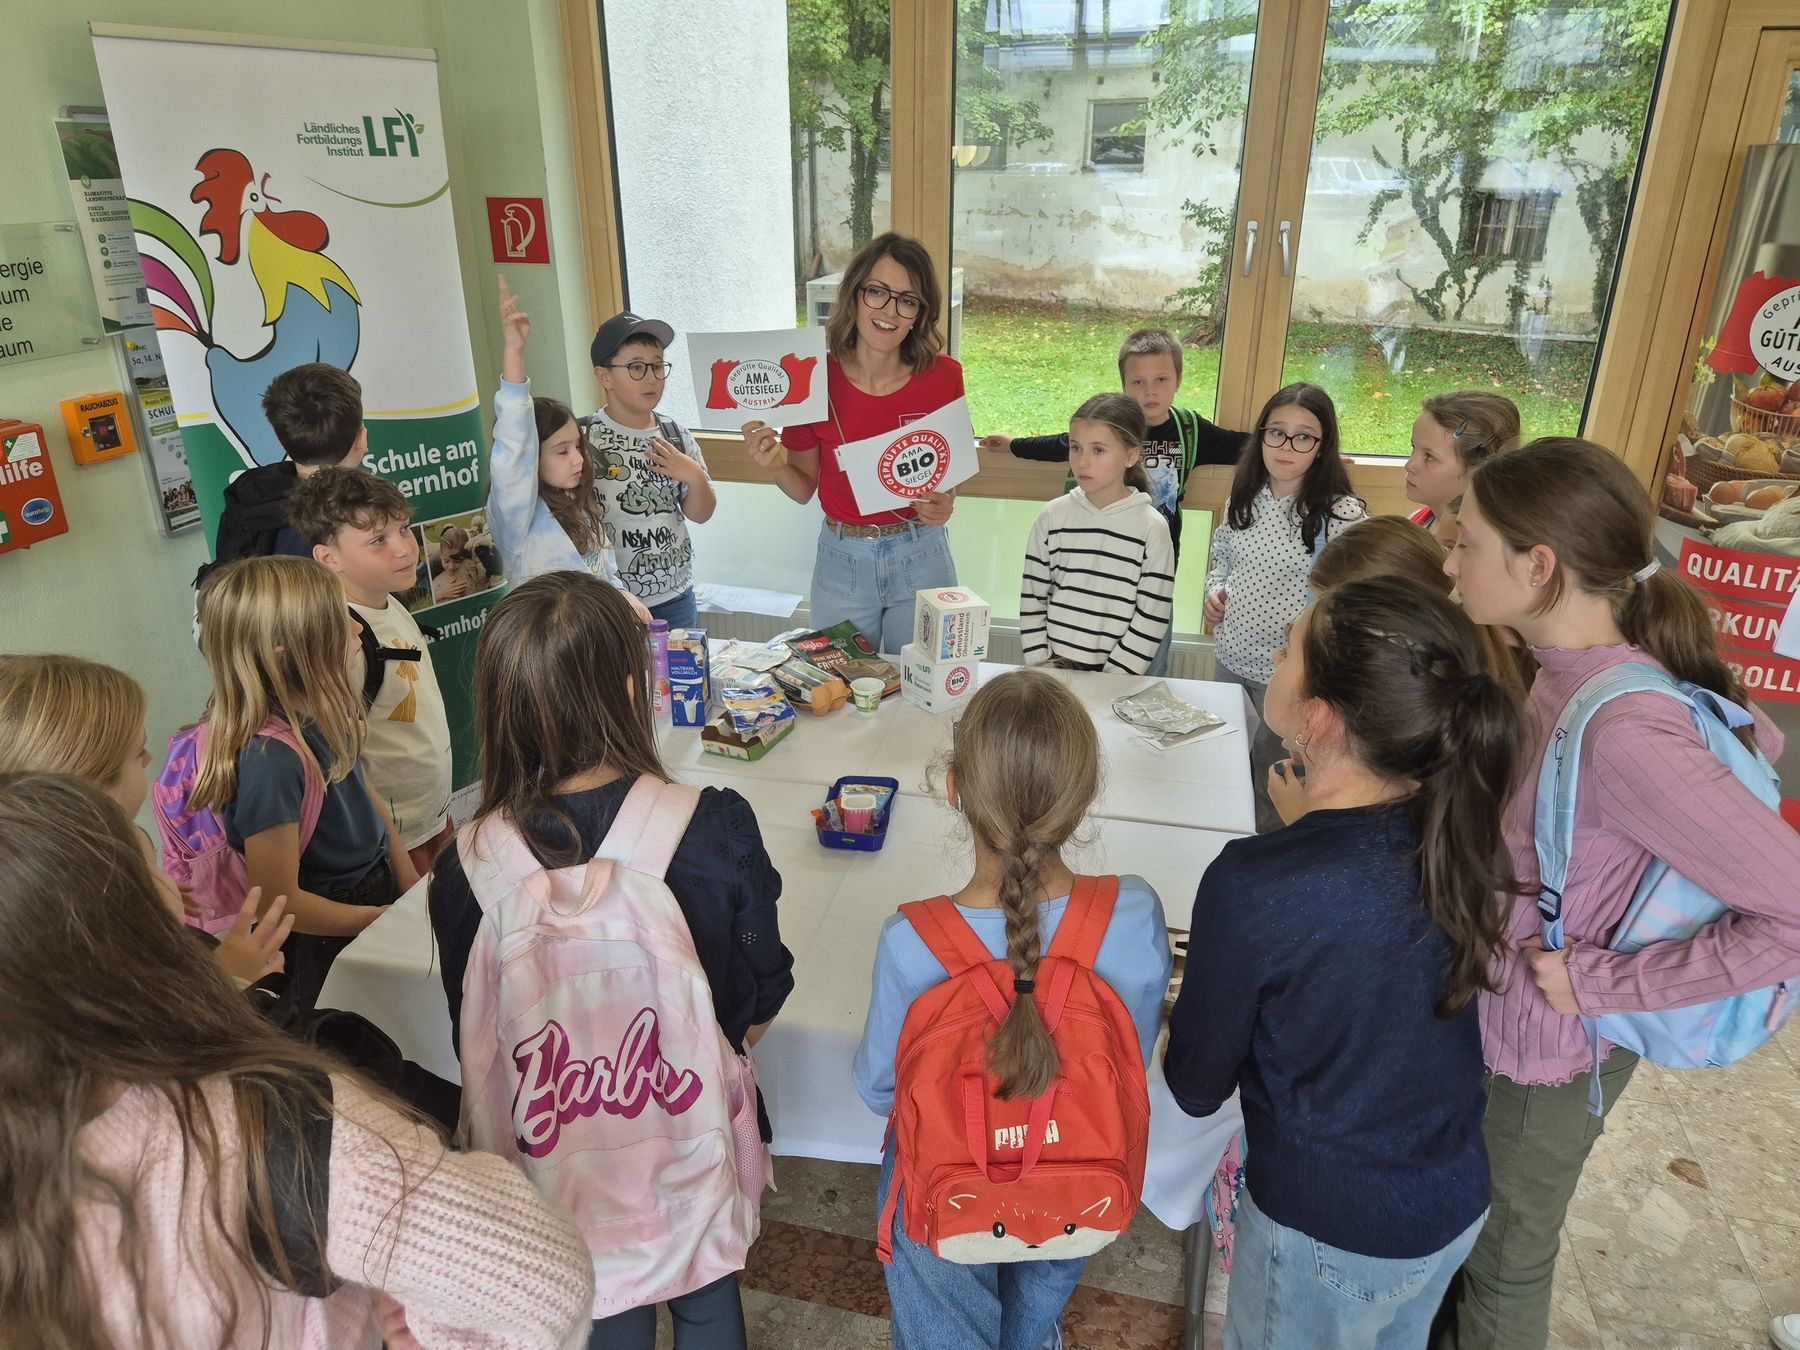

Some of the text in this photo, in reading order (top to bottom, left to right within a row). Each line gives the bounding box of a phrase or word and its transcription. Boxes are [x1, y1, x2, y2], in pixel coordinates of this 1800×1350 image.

[303, 122, 360, 134] Ländliches
[362, 107, 421, 157] LFI
[296, 133, 362, 147] Fortbildungs
[326, 146, 364, 157] Institut
[0, 257, 44, 280] ergie
[1763, 290, 1800, 319] Gepr
[0, 317, 13, 332] e
[1761, 328, 1800, 352] GÜT
[155, 352, 162, 361] N
[730, 362, 785, 382] Geprüfte Qualität
[745, 372, 770, 385] AMA
[733, 383, 785, 396] GÜTESIEGEL
[80, 398, 119, 413] RAUCHABZUG
[742, 397, 777, 407] AUSTRIA
[362, 439, 478, 475] Schule am
[882, 434, 948, 485] GEPRÜFTE QUALITÄT
[901, 446, 924, 460] AMA
[896, 452, 935, 477] BIO
[396, 458, 479, 498] ernhof
[905, 469, 933, 485] SIEGEL
[955, 612, 965, 659] Genussland
[951, 676, 965, 686] BIO
